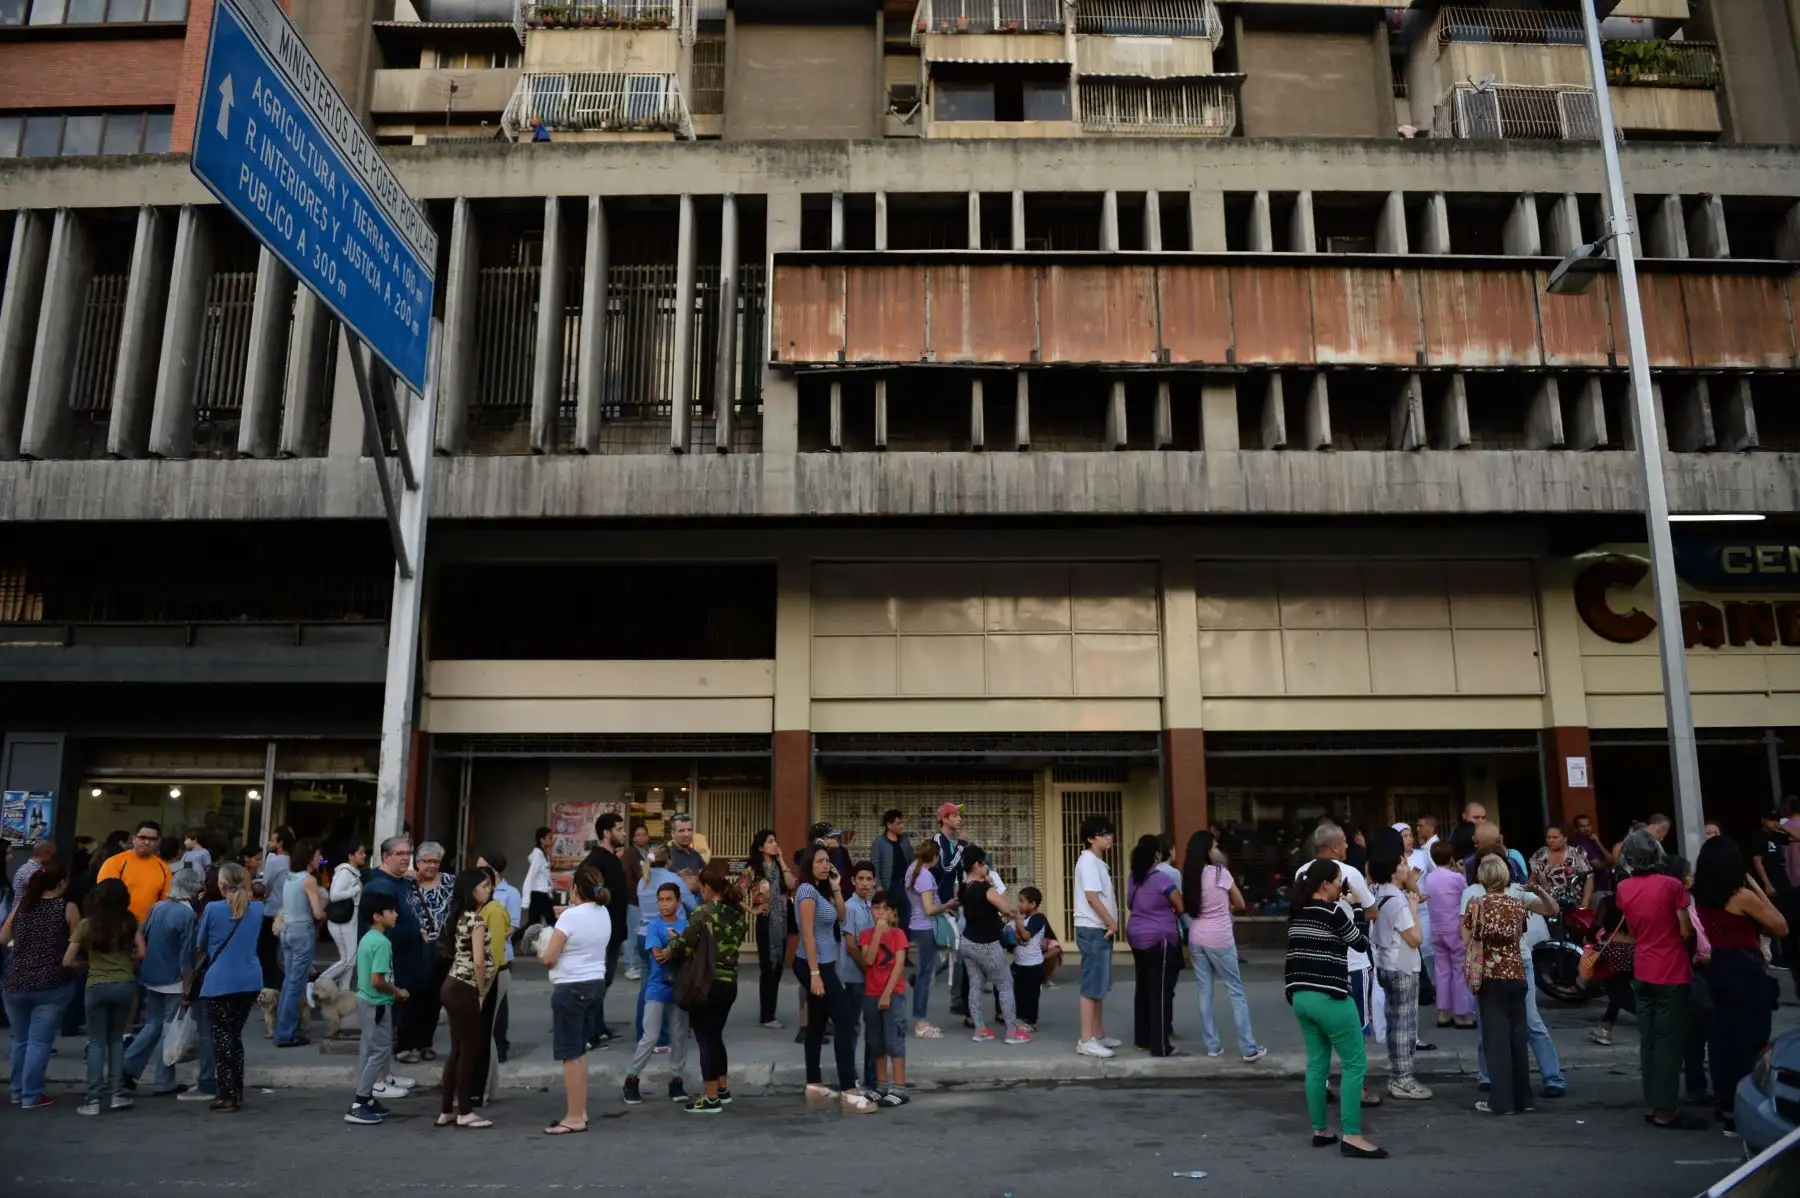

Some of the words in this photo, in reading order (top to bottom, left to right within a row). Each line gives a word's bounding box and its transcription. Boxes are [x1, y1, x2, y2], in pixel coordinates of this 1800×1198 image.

[239, 162, 293, 240] PUBLICO
[297, 228, 306, 256] A
[313, 245, 336, 283] 300
[337, 278, 347, 298] m
[252, 76, 335, 198] AGRICULTURA
[342, 183, 349, 210] Y
[353, 199, 390, 264] TIERRAS
[393, 253, 399, 276] A
[402, 263, 415, 296] 100
[416, 288, 423, 305] m
[260, 135, 327, 231] INTERIORES
[332, 217, 340, 243] Y
[342, 234, 380, 293] JUSTICIA
[384, 282, 391, 305] A
[394, 293, 411, 327] 200
[412, 319, 419, 337] m
[279, 25, 348, 143] MINISTERIOS
[351, 129, 368, 174] DEL
[371, 158, 398, 214] PODER
[400, 198, 434, 259] POPULAR
